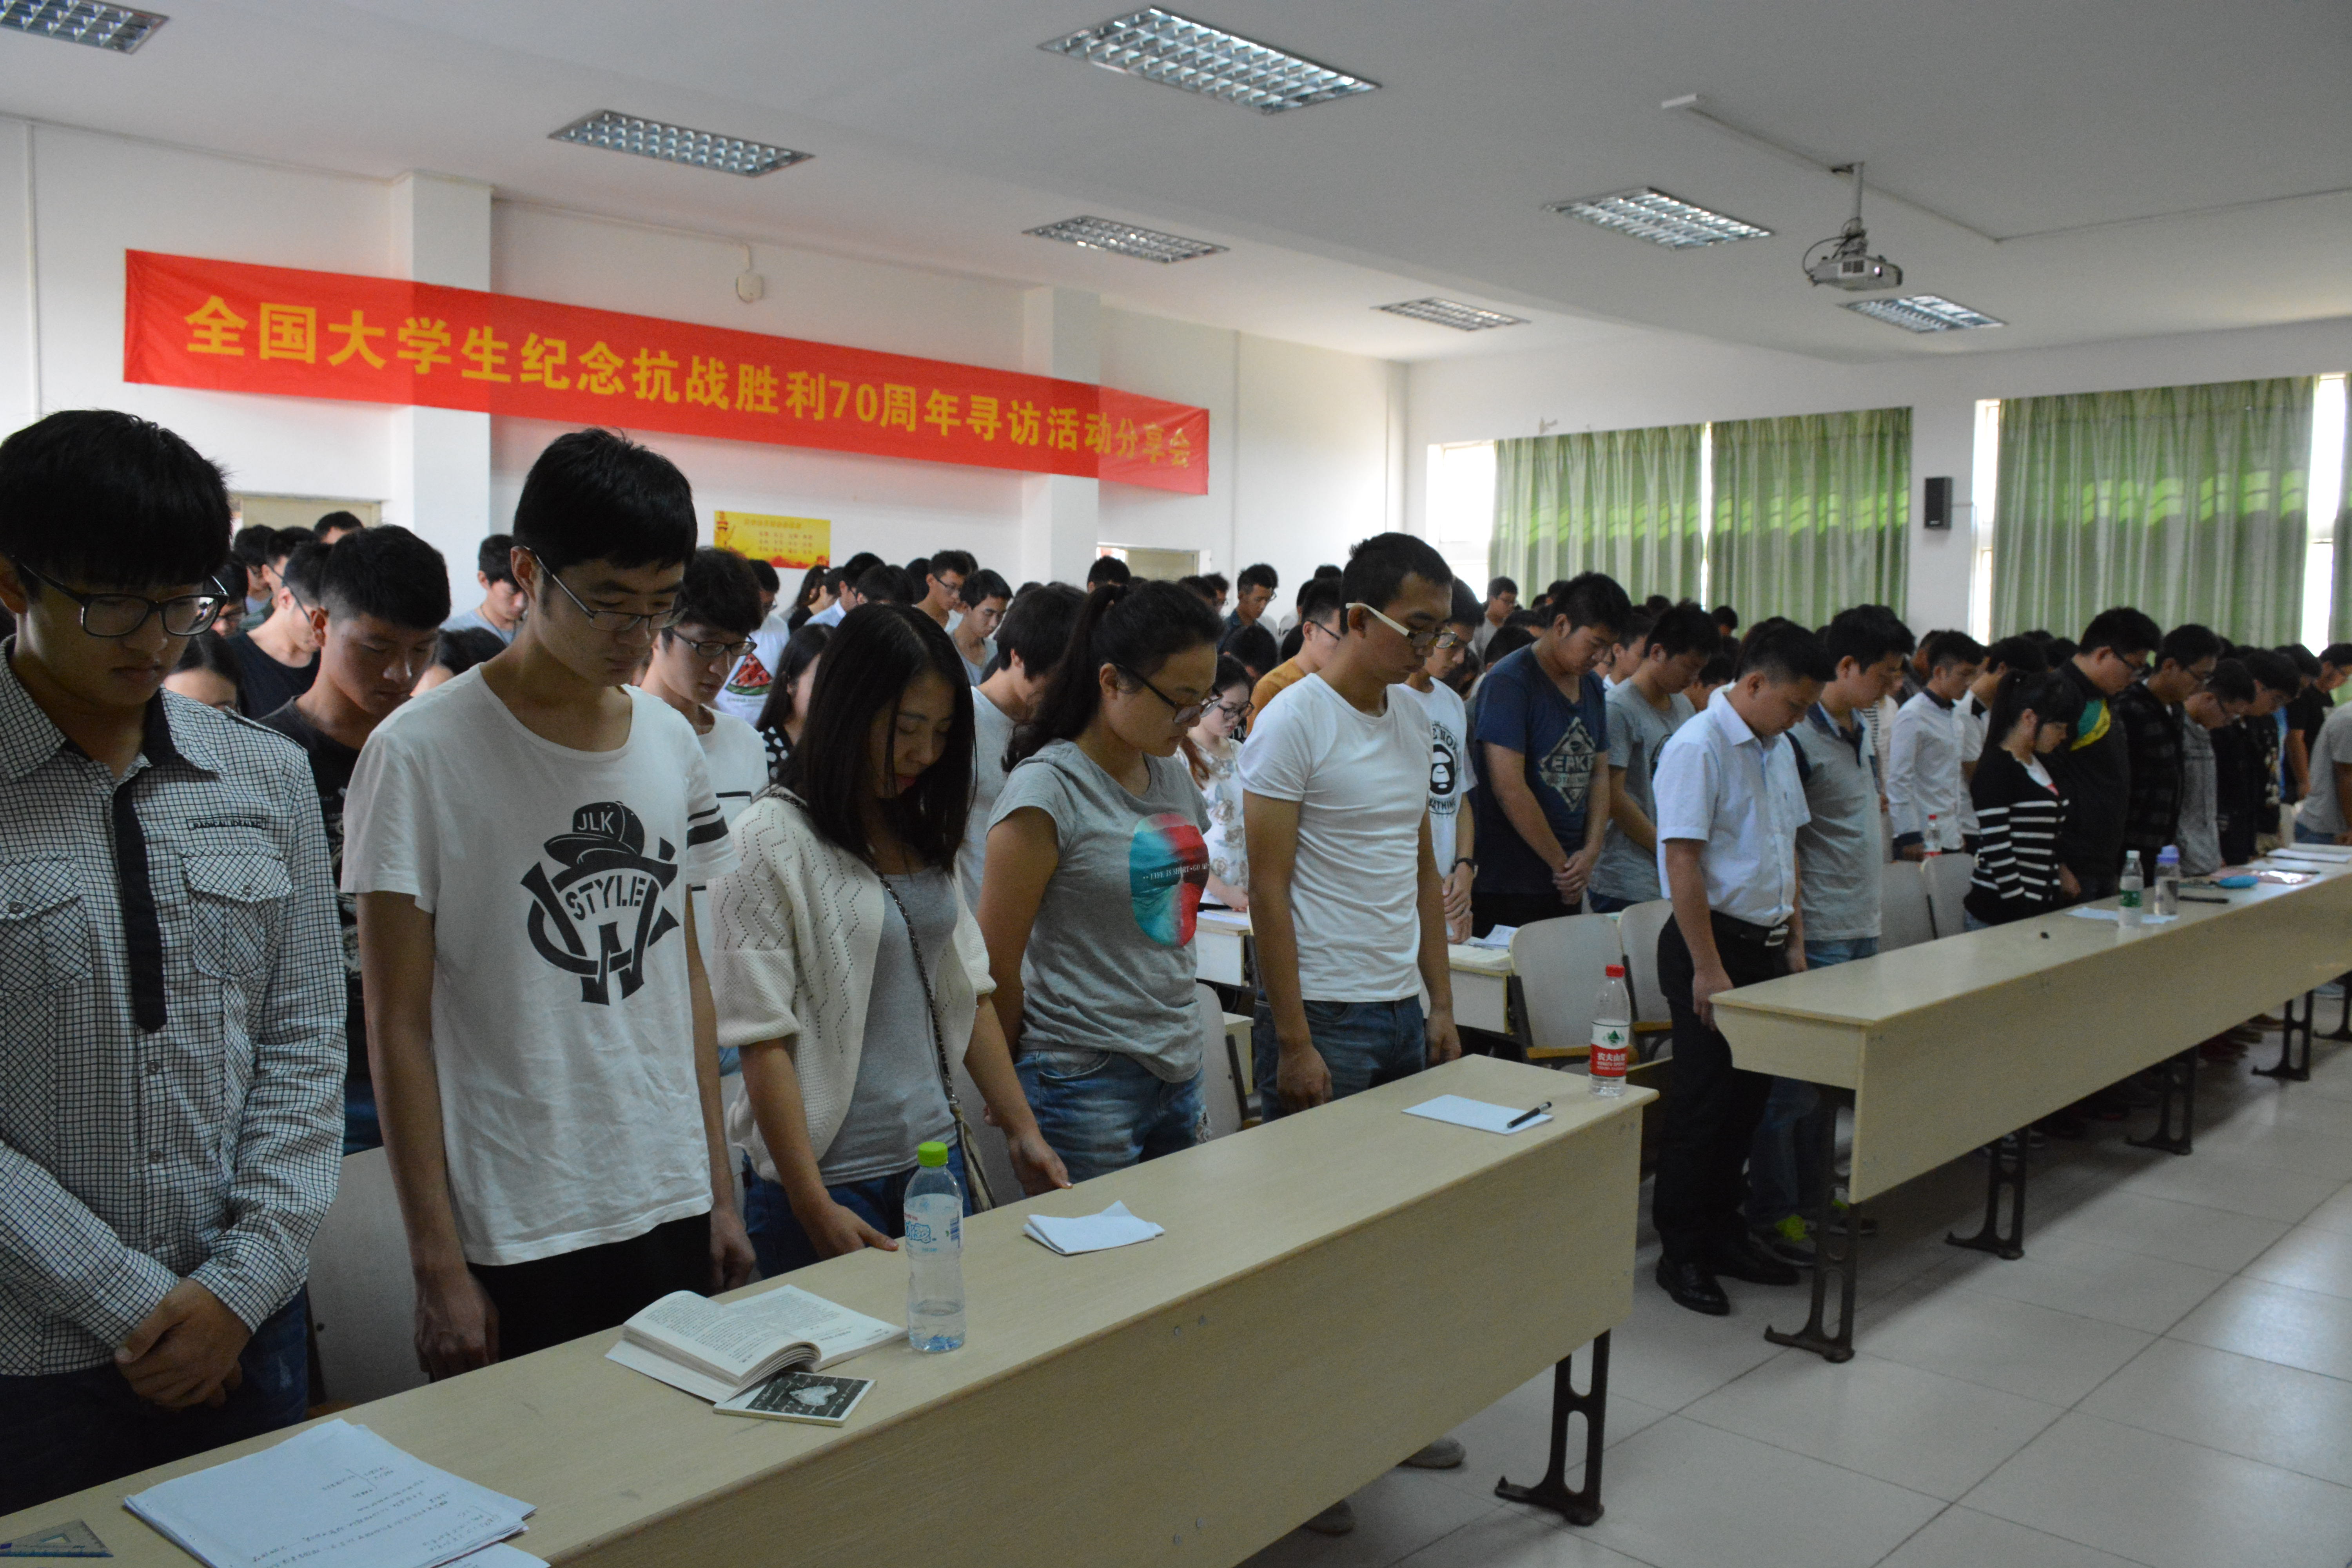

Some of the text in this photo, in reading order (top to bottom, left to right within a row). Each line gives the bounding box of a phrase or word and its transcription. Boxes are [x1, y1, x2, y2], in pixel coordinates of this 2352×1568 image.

[184, 295, 1191, 468] 全国大学生纪念抗战胜利70周年寻访活动分享会
[577, 811, 614, 834] JLK
[1151, 871, 1163, 880] LIFE
[1173, 866, 1189, 875] SHORT
[565, 875, 647, 921] STYLE
